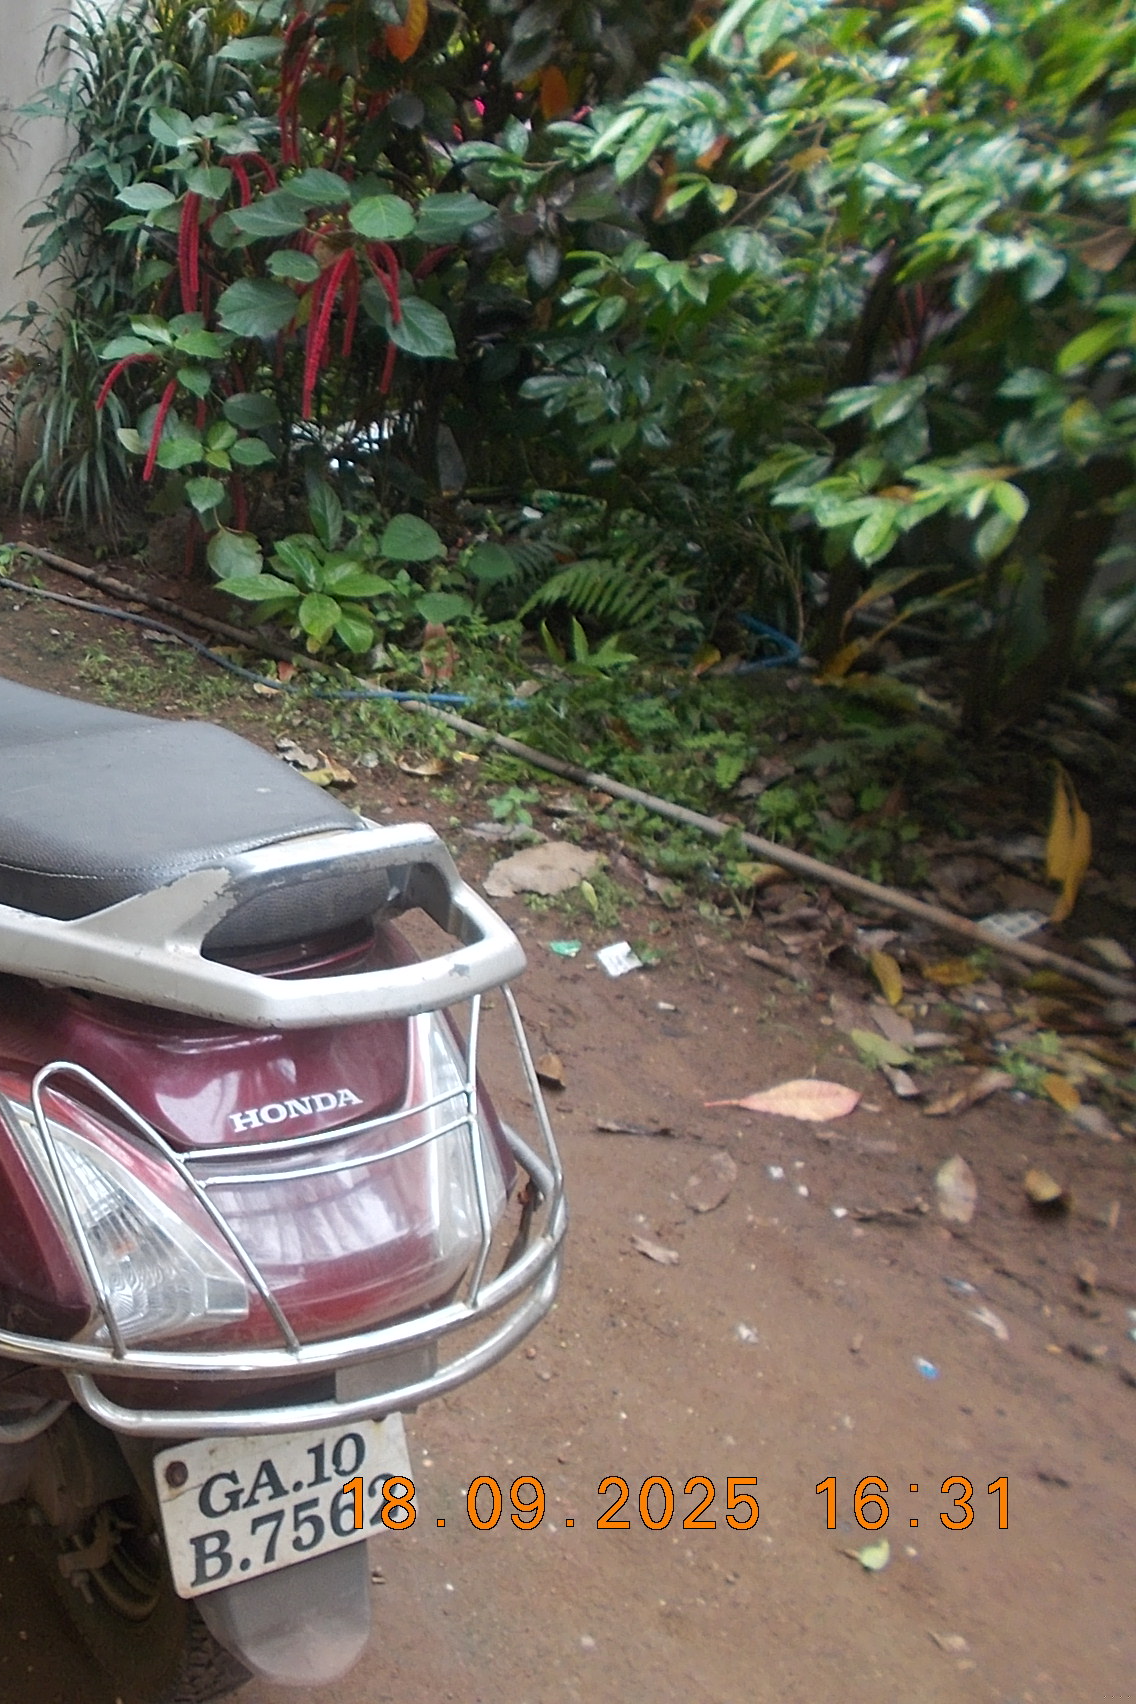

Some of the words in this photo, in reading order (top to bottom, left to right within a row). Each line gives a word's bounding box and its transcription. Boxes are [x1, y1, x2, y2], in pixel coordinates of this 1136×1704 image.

[228, 1088, 364, 1133] HONDA
[198, 1432, 366, 1520] GA.10
[189, 1472, 404, 1589] B.7562
